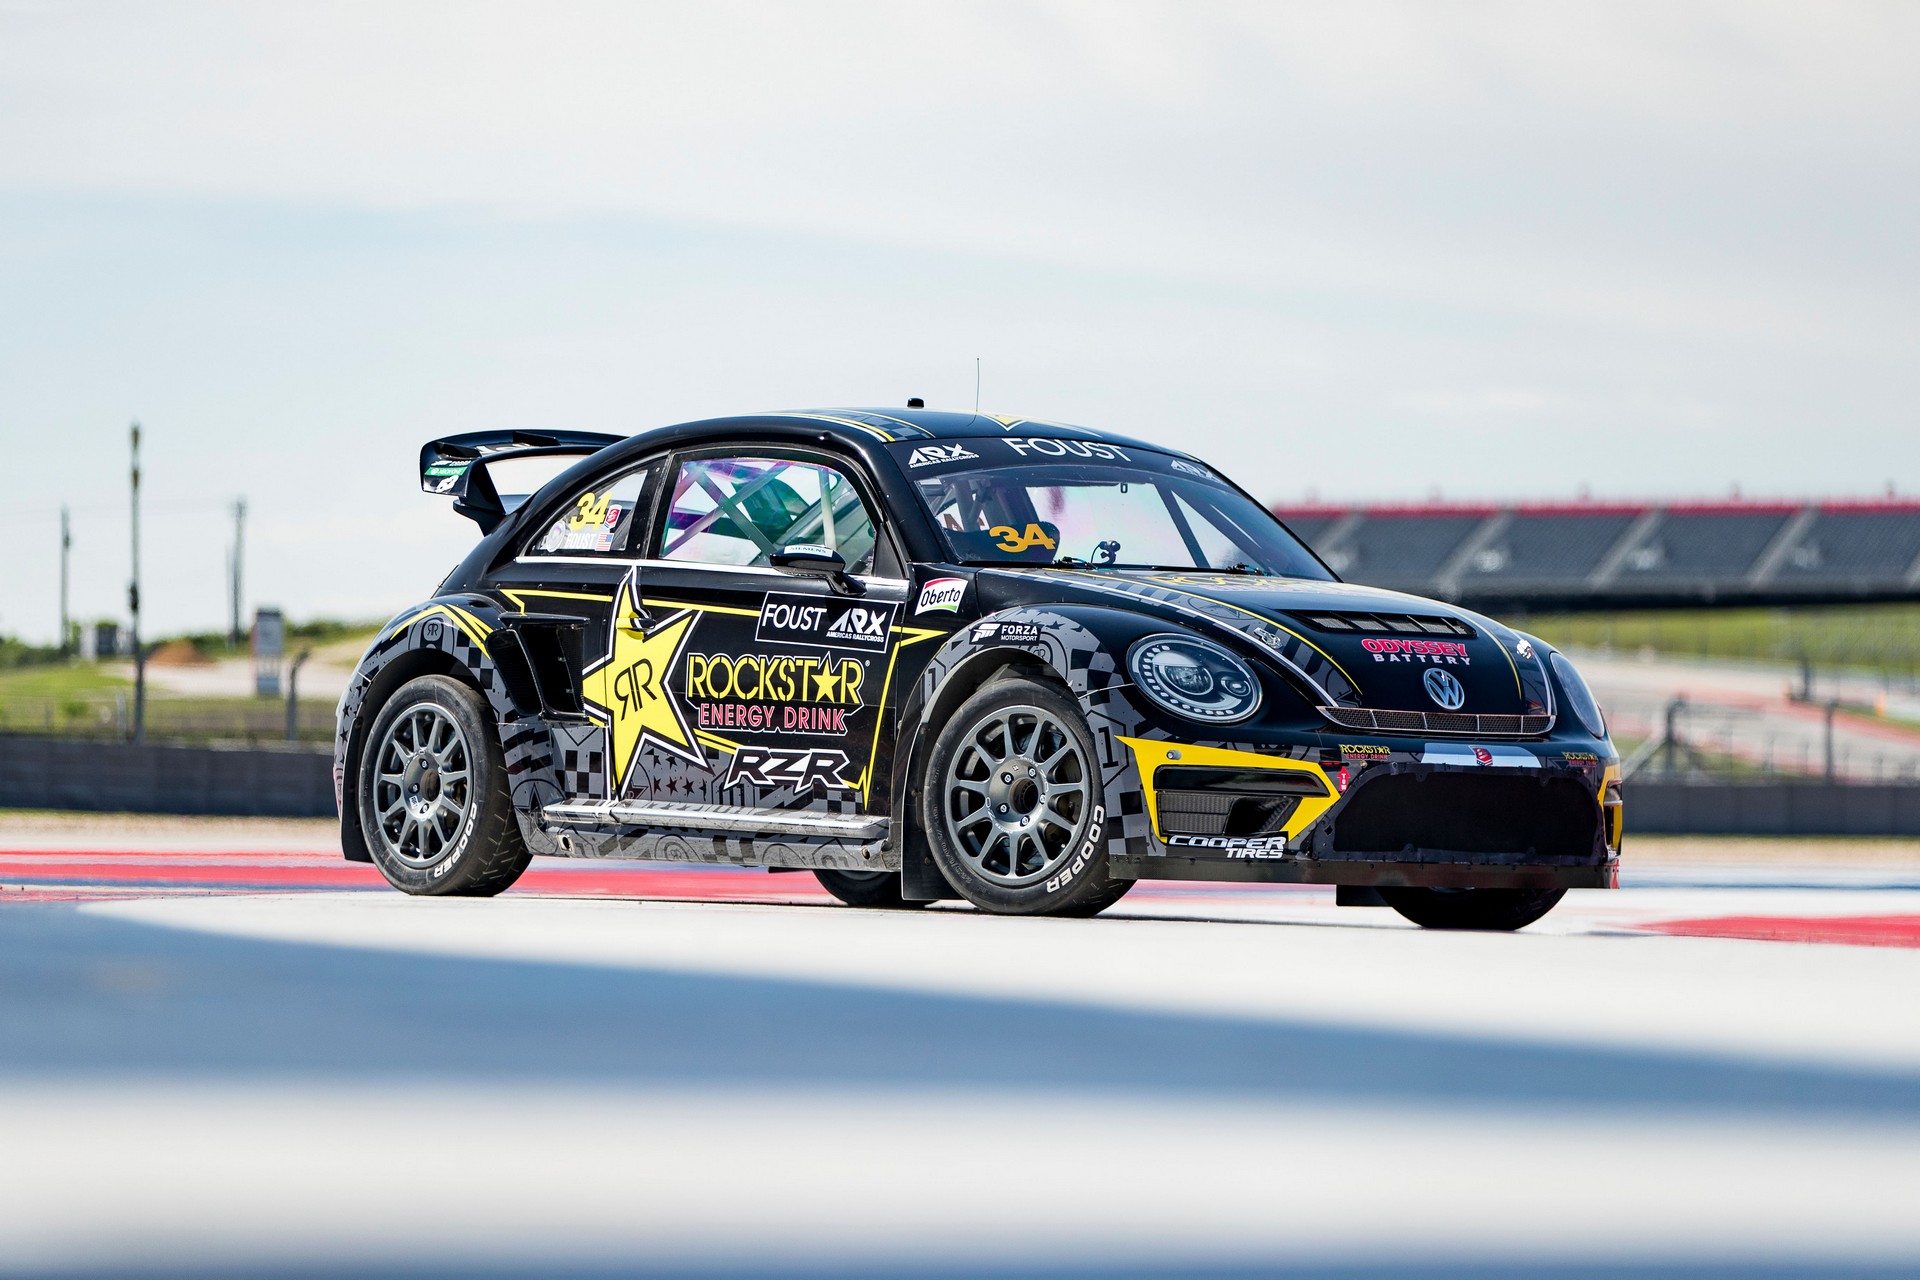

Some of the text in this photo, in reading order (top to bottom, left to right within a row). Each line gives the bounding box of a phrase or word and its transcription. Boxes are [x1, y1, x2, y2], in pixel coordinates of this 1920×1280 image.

[1001, 437, 1131, 462] FOUST
[570, 491, 612, 531] 34
[565, 533, 596, 549] FOUST
[989, 523, 1056, 553] 34
[920, 587, 961, 608] Oberto
[762, 603, 827, 631] FOUST
[826, 631, 884, 643] AMERICAS RALLYCROSS
[1001, 625, 1038, 635] FORZA
[1361, 638, 1468, 657] ODYSSEY
[1372, 653, 1471, 666] BATTERY
[700, 703, 846, 731] ENERGY DRINK
[723, 746, 850, 793] RZR
[433, 802, 478, 878] COOPER
[1046, 804, 1105, 893] COOPER
[1169, 835, 1287, 849] COOPER
[1225, 848, 1283, 859] TIRES
